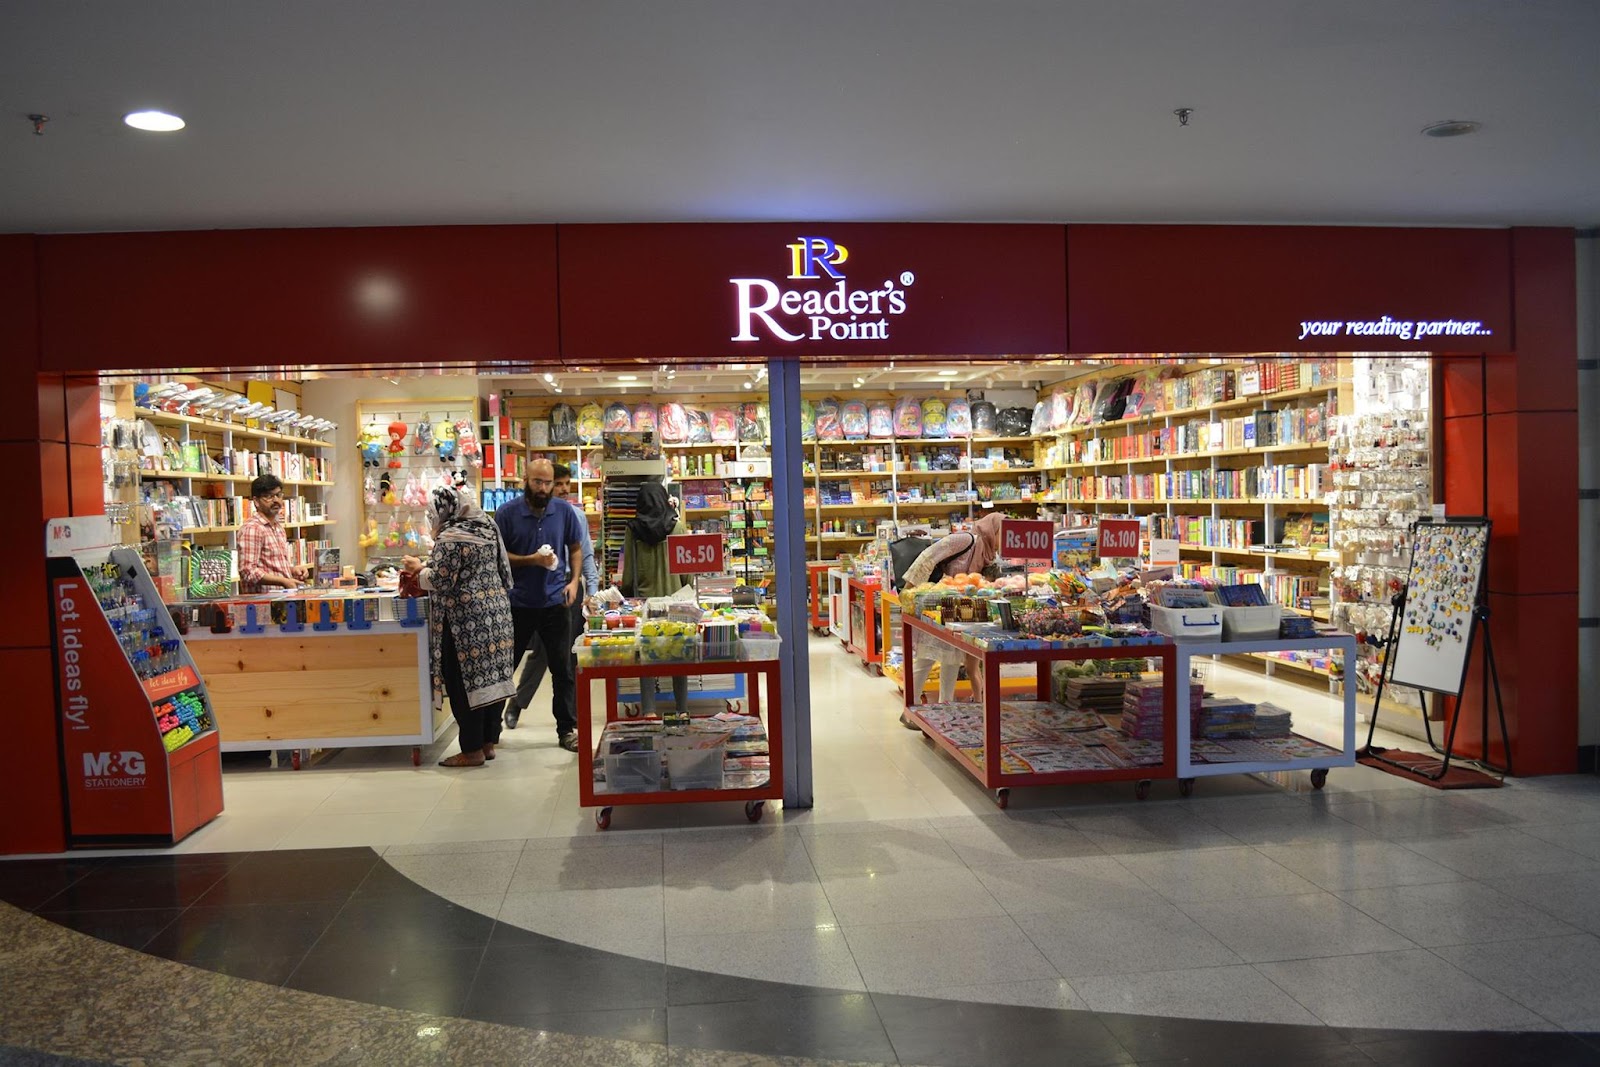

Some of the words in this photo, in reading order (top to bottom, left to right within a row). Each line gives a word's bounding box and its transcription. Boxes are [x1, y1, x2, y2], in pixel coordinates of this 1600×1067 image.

[729, 278, 907, 342] Reader's
[808, 314, 889, 340] Point
[1298, 320, 1342, 340] your
[1345, 315, 1414, 340] reading
[1413, 318, 1491, 340] partner...
[57, 583, 81, 622] Let
[62, 628, 83, 691] ideas
[65, 695, 90, 730] fly!
[82, 751, 146, 777] M&G
[84, 777, 147, 788] STATIONERY
